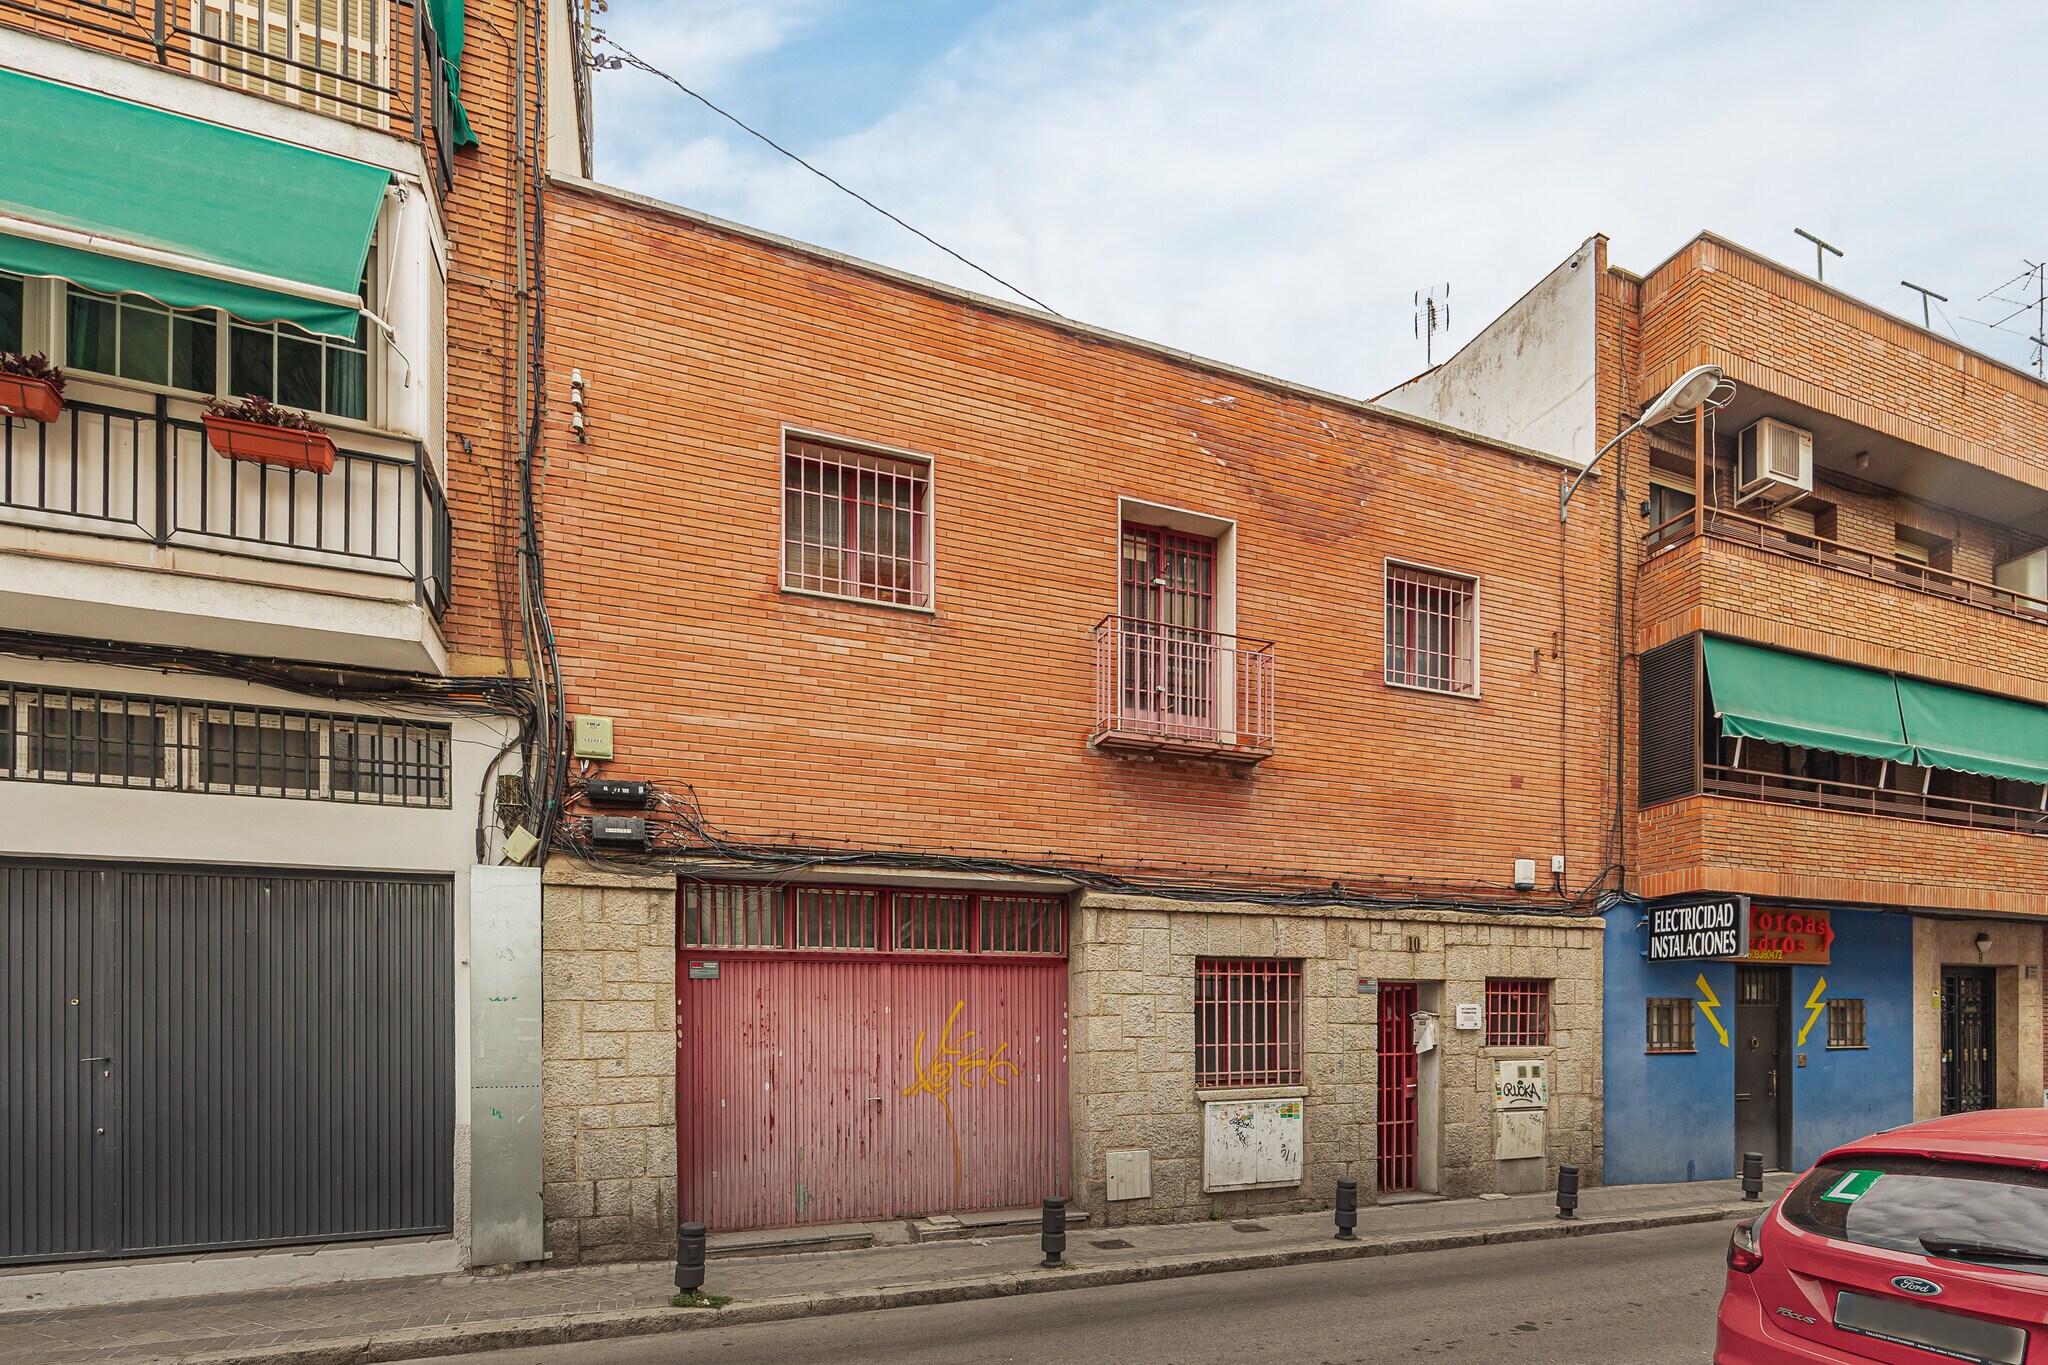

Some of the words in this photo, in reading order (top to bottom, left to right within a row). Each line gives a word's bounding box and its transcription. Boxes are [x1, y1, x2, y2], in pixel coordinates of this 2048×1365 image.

[1654, 903, 1734, 933] ELECTRICIDAD
[1408, 936, 1420, 951] 10
[1651, 930, 1736, 959] INSTALACIONES
[1978, 952, 1983, 963] 8
[1827, 1172, 1860, 1200] L
[1900, 1279, 1929, 1293] Ford
[1776, 1307, 1817, 1324] FOCUS
[1887, 1336, 1915, 1346] SANTANDER
